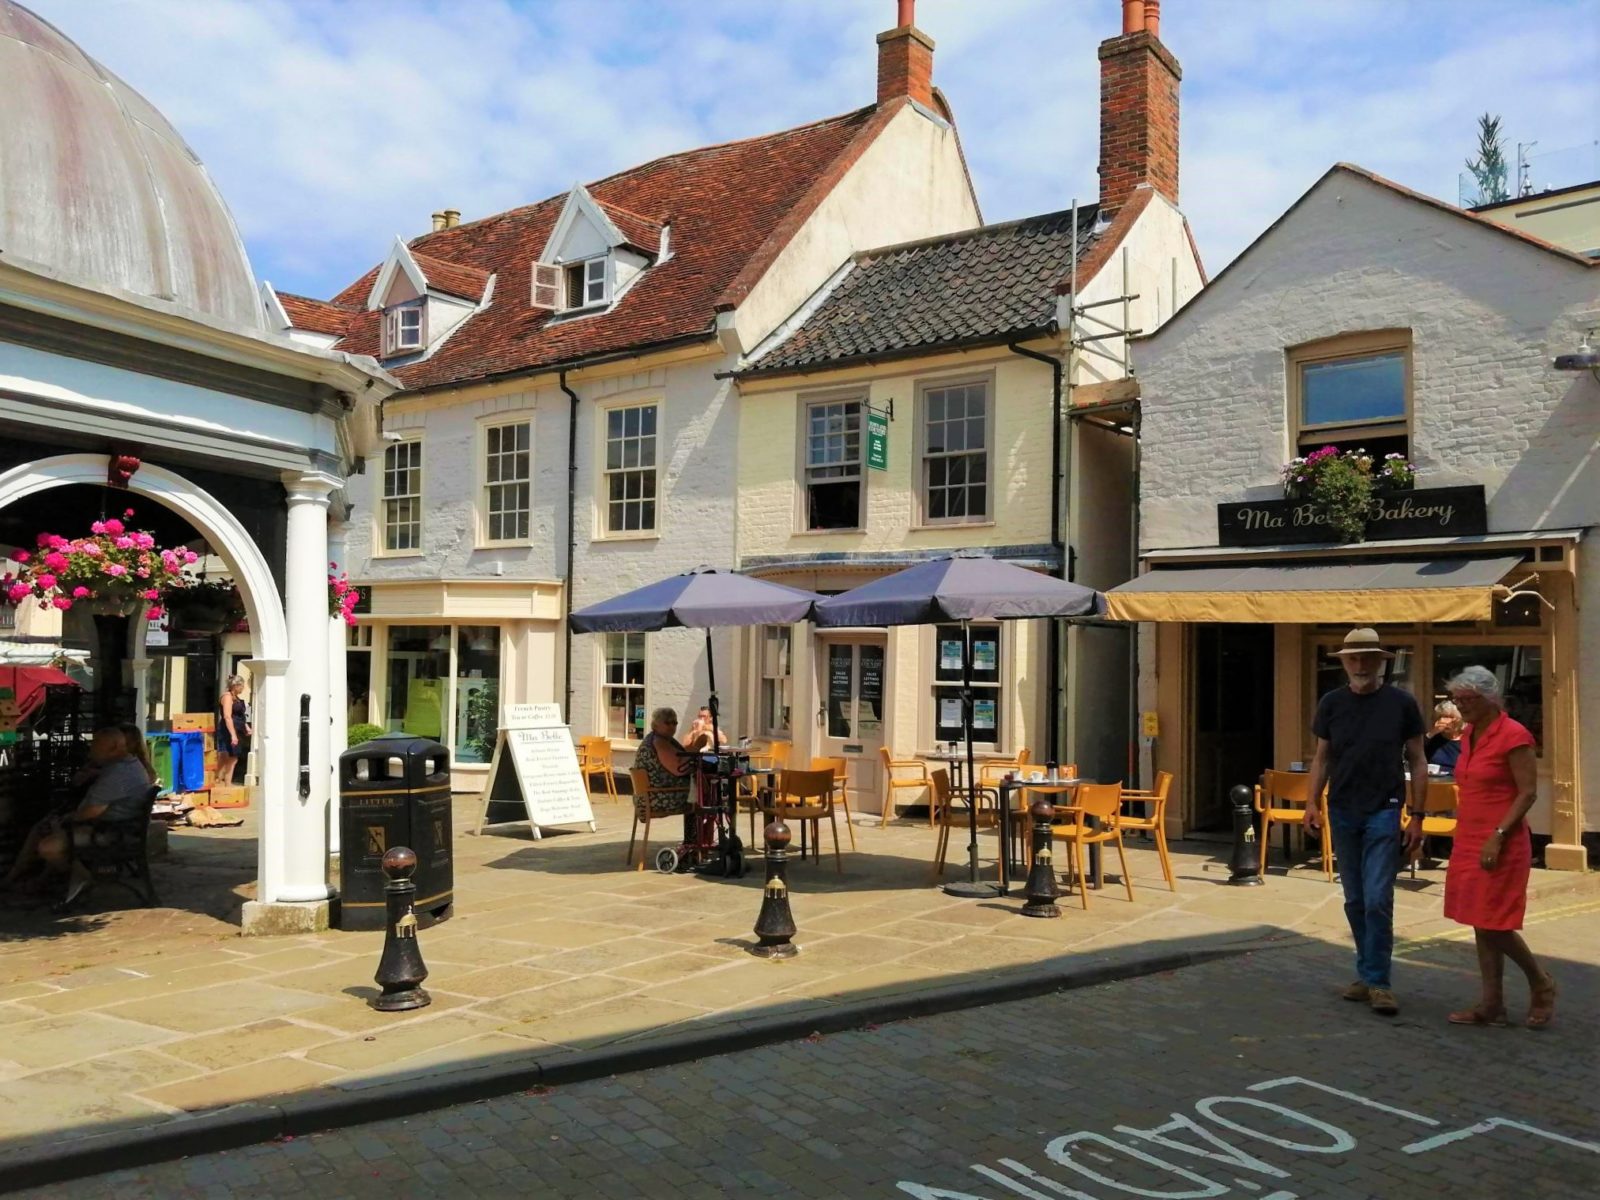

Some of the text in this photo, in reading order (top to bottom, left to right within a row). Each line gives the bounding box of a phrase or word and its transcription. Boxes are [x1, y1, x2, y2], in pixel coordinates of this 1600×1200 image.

[1237, 508, 1286, 529] Ma
[1367, 497, 1456, 525] Bakery
[541, 730, 563, 741] Belle
